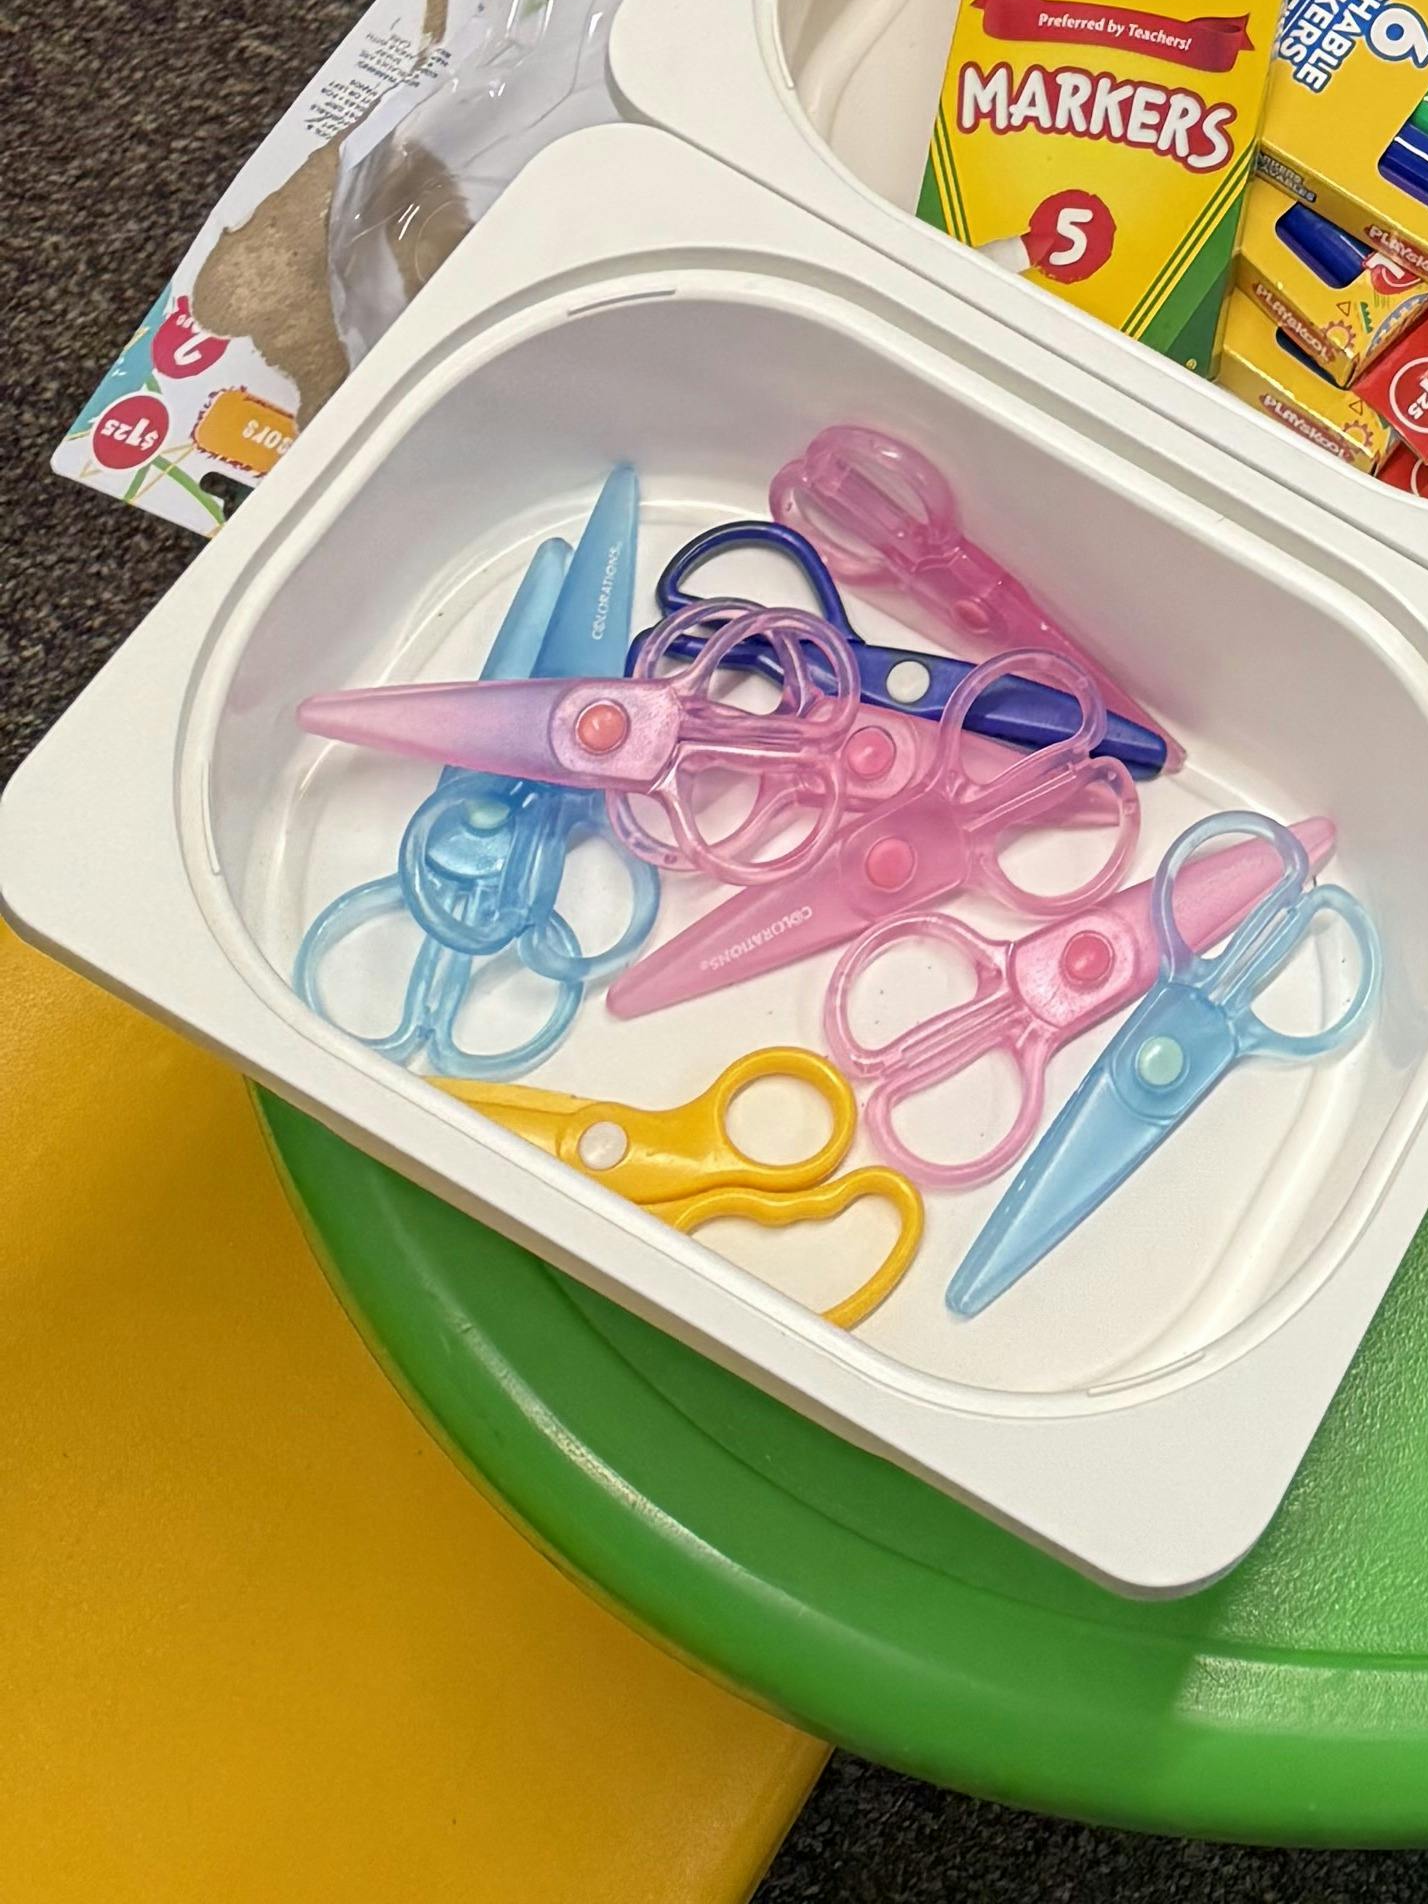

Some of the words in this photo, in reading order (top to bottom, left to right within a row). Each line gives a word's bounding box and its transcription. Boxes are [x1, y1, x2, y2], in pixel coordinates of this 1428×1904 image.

[1038, 12, 1105, 32] Preferred
[1107, 19, 1125, 38] by
[1128, 23, 1193, 51] Teachers!
[961, 65, 1233, 170] MARKERS
[1048, 207, 1094, 267] 5
[1255, 283, 1331, 361] PLAYSKOOL
[1263, 394, 1349, 462] PLAYSKOOL
